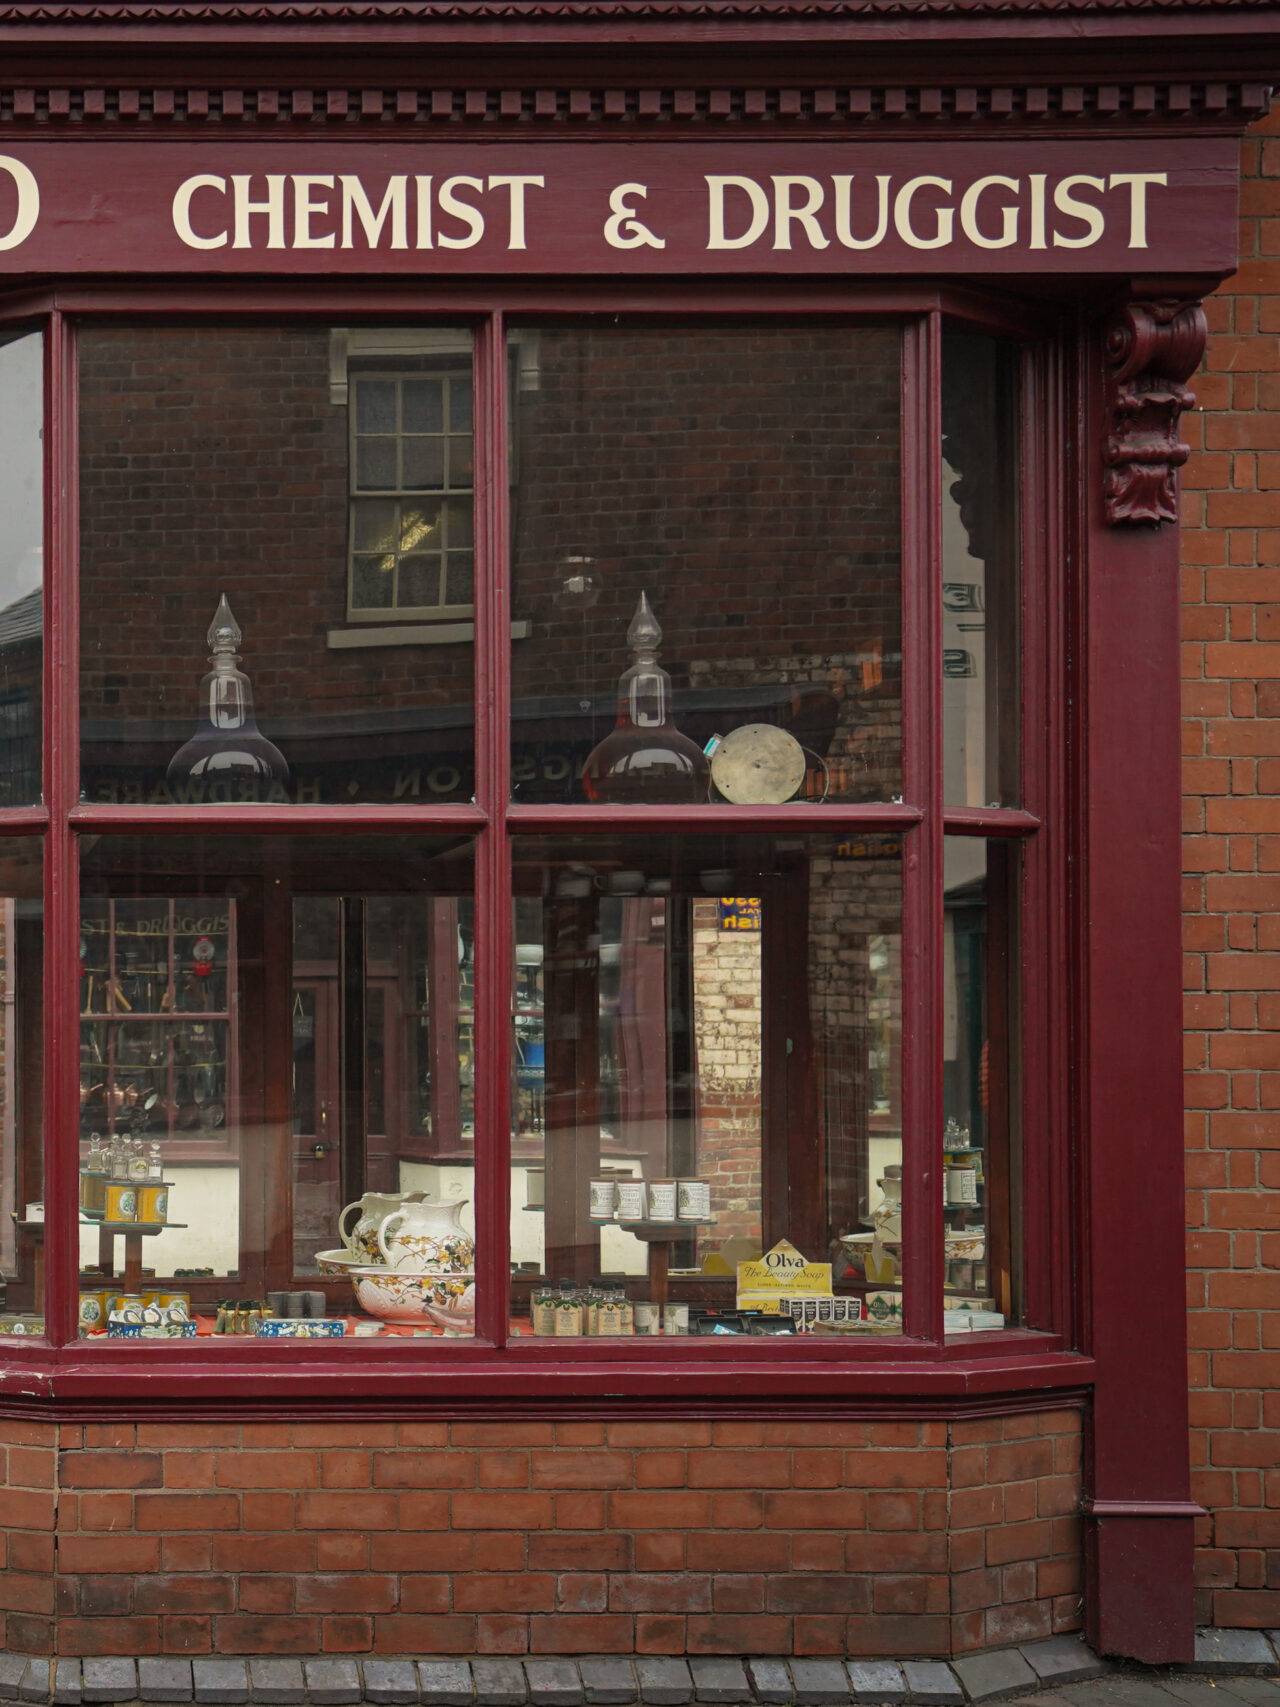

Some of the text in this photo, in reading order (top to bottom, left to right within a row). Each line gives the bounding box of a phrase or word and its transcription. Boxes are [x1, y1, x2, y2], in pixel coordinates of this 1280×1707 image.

[172, 172, 1167, 250] CHEMIST & DRUGGIST
[136, 914, 230, 934] DRUGGIS
[766, 1253, 805, 1268] Olva
[744, 1266, 762, 1278] The
[762, 1266, 799, 1281] Beauty
